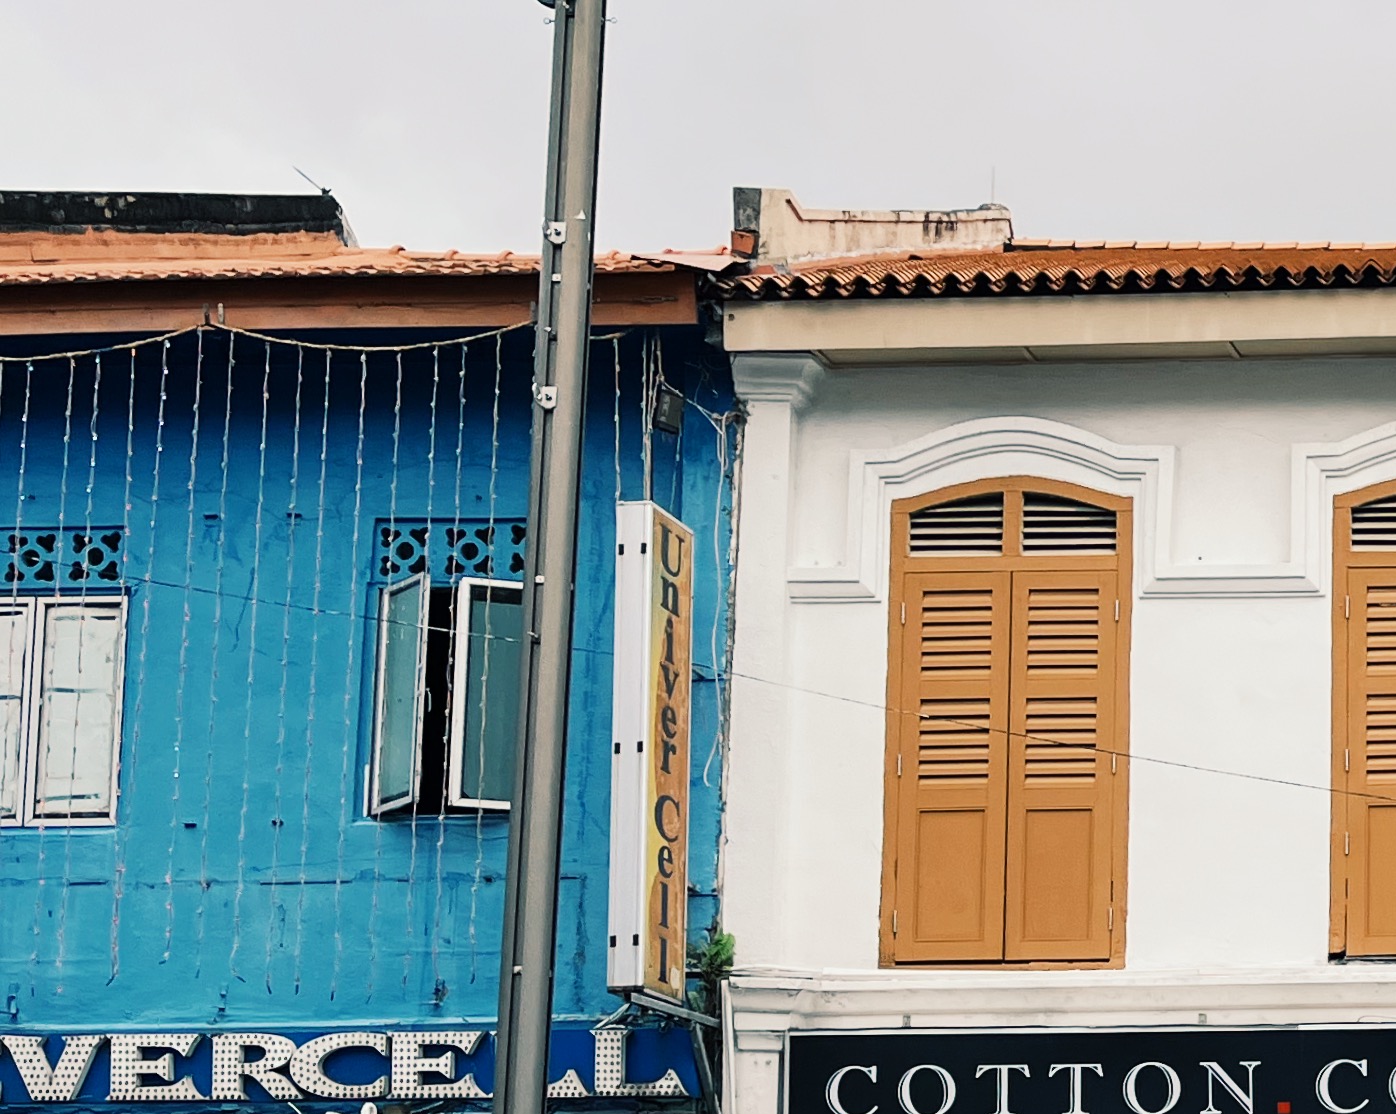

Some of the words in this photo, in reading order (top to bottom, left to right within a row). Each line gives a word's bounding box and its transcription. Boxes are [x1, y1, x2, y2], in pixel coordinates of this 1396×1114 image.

[659, 522, 687, 777] Univer
[653, 798, 682, 985] Cell
[0, 1031, 688, 1101] VERCEL
